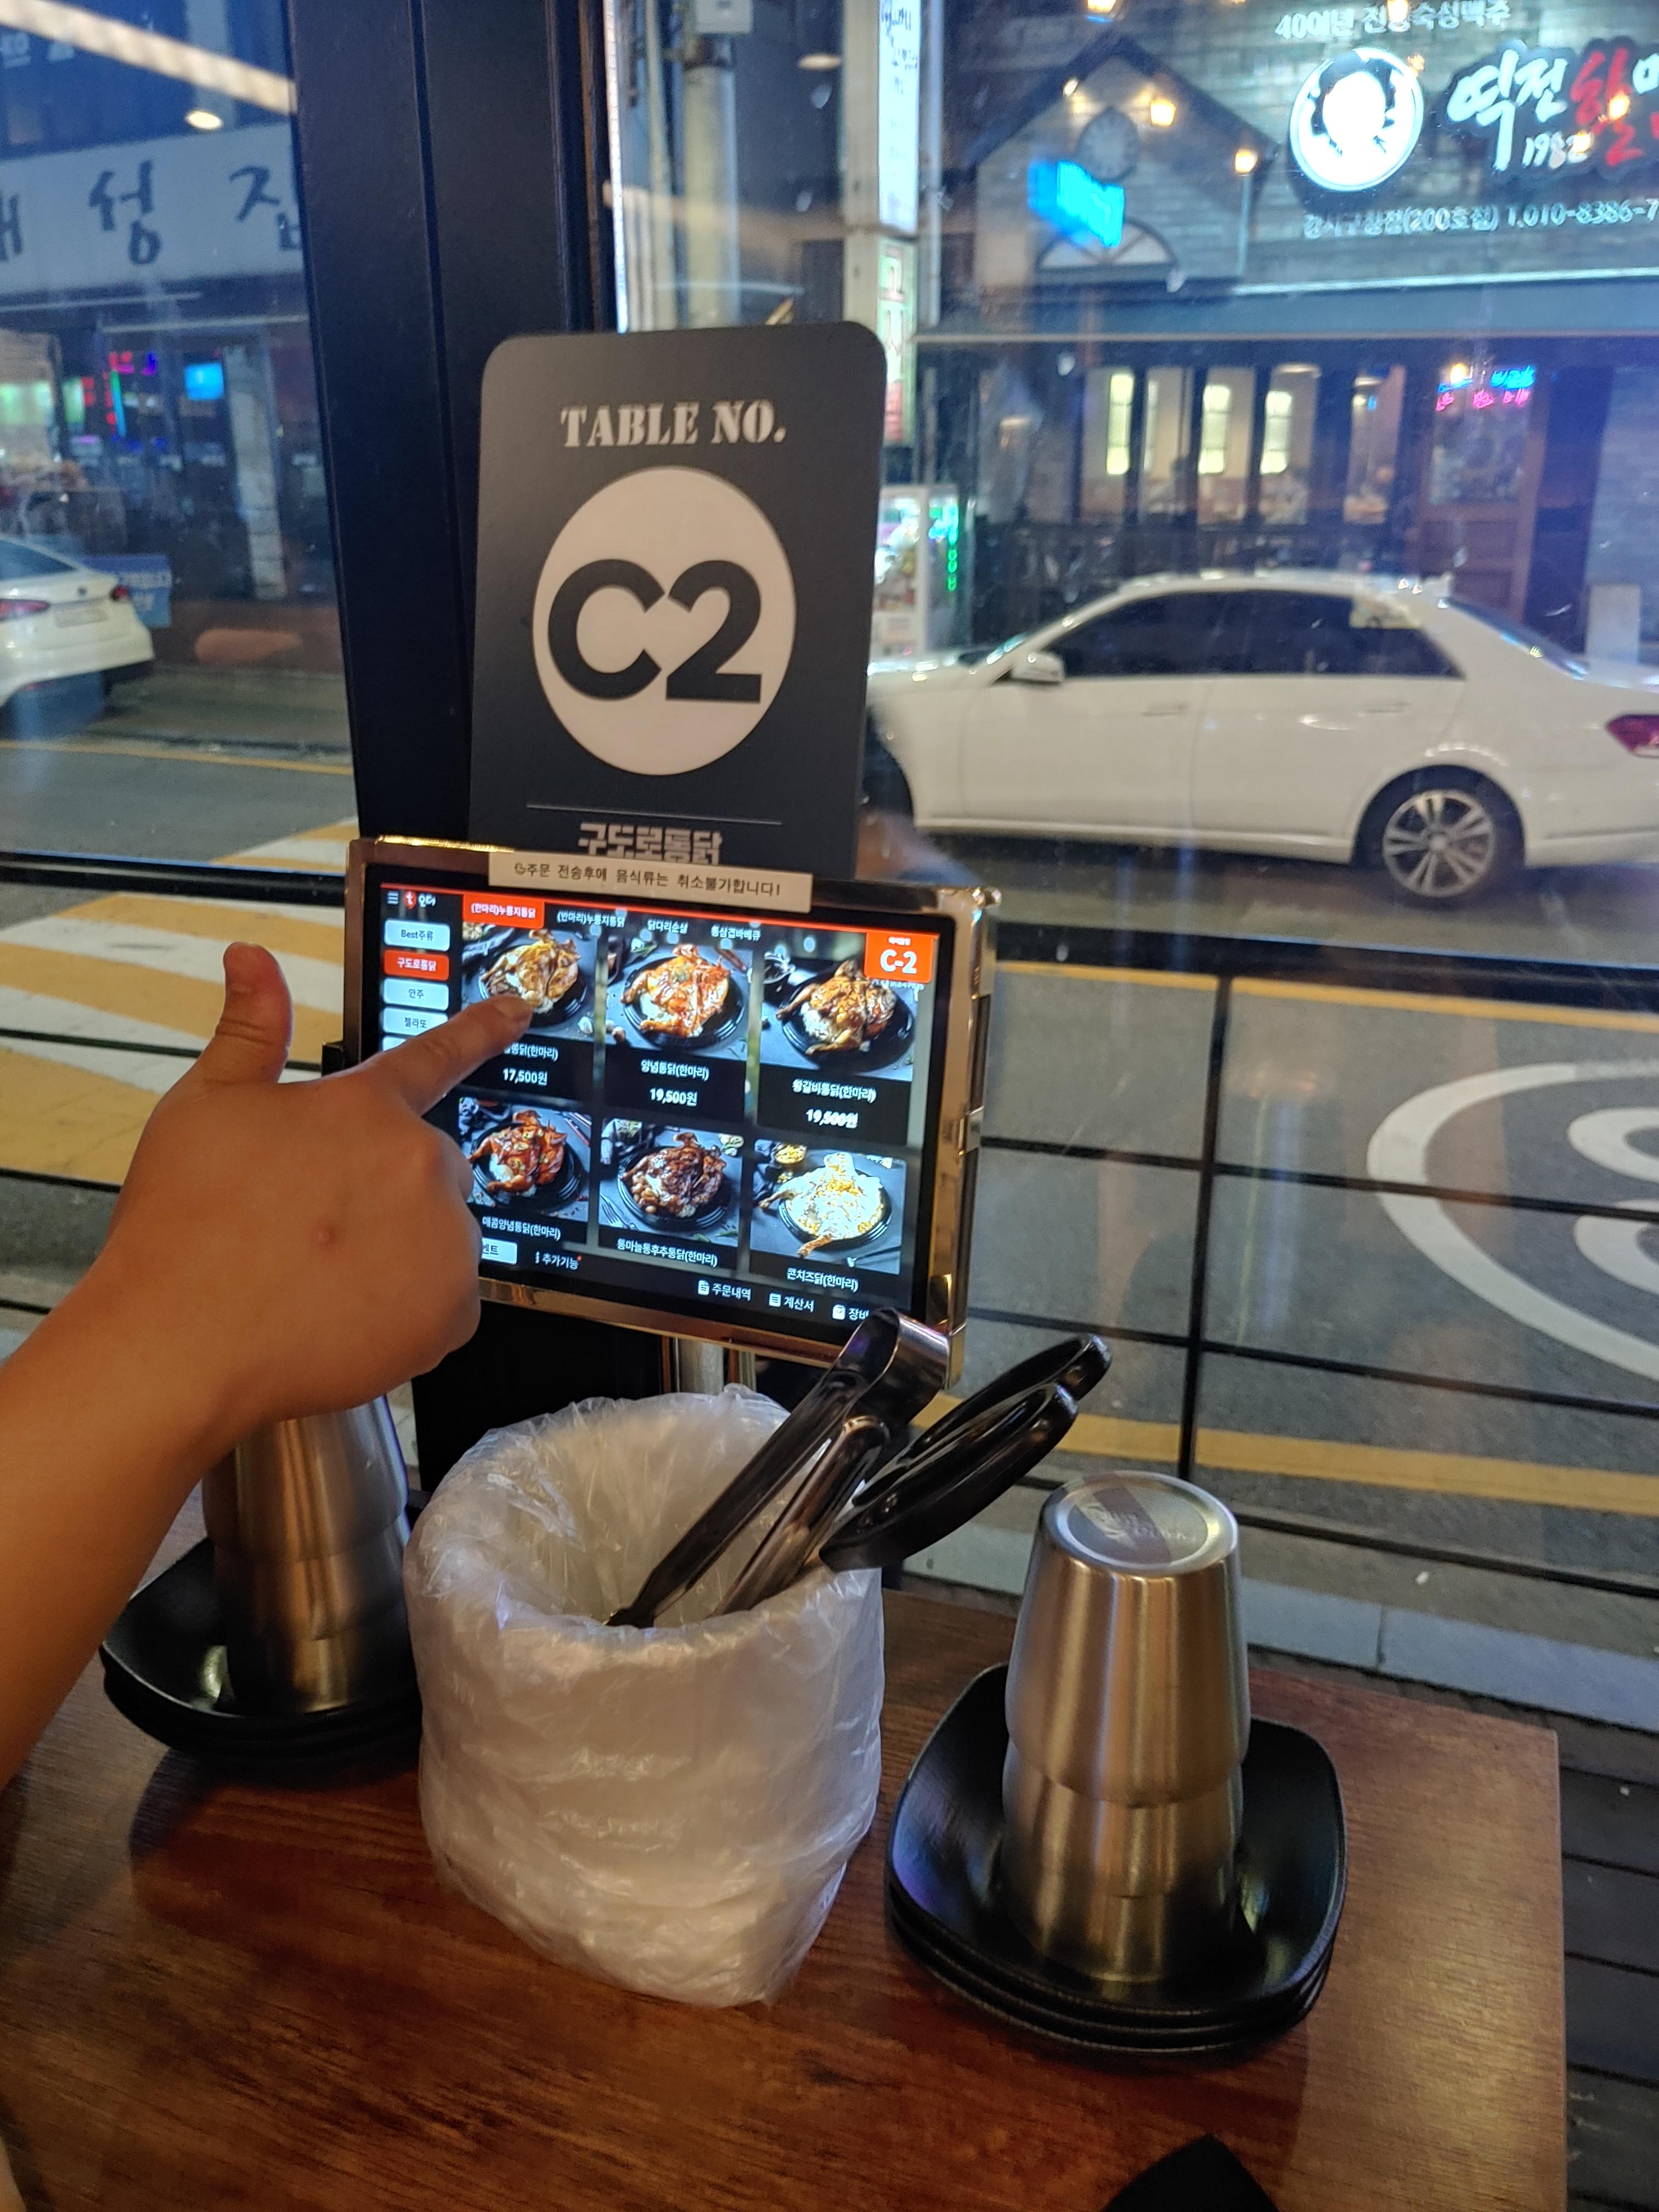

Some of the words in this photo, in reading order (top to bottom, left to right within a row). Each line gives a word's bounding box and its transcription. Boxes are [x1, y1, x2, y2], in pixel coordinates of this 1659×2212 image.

[560, 402, 699, 448] TABLE
[711, 399, 787, 444] NO.
[548, 558, 762, 704] C2
[578, 822, 723, 865] 구도로통닭
[557, 865, 607, 881] 전송후에
[616, 868, 669, 887] 음식류는
[401, 929, 433, 941] Best주류
[397, 956, 437, 972] 구도로통닭
[880, 949, 917, 974] C-2
[408, 989, 425, 1000] 안주
[404, 1017, 427, 1029] 젤라또
[503, 1068, 548, 1086] 17,500원
[640, 1058, 710, 1082] 양념통닭(한마리)
[650, 1087, 698, 1107] 19,500원
[792, 1078, 877, 1104] 왕갈비통닭(한마리)
[805, 1108, 859, 1130] 19,500원
[482, 1215, 561, 1242] 매콤양념통닭(한마리)
[541, 1252, 579, 1271] 추가기능
[786, 1266, 860, 1293] 콘치즈닭(한마리)
[712, 1282, 752, 1302] 주문내역
[782, 1296, 815, 1313] 계산서
